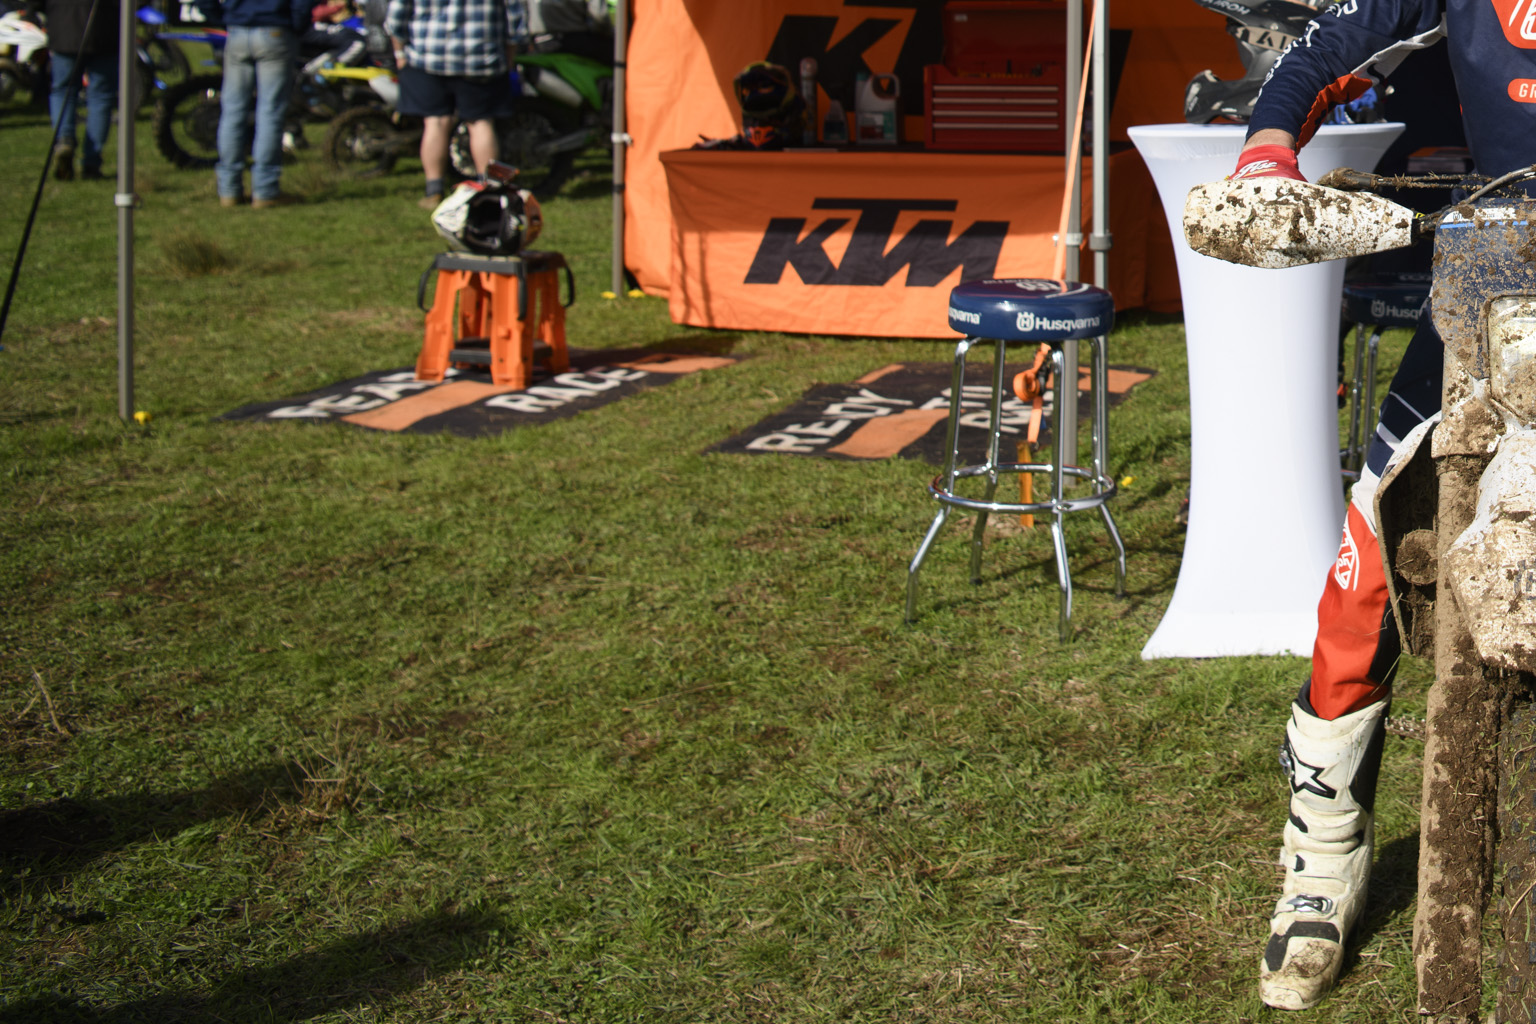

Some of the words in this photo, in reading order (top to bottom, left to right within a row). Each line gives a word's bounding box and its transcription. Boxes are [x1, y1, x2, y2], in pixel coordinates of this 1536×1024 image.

[743, 197, 1011, 288] KTM
[1035, 317, 1100, 332] Husqvarna
[485, 366, 649, 413] RACE
